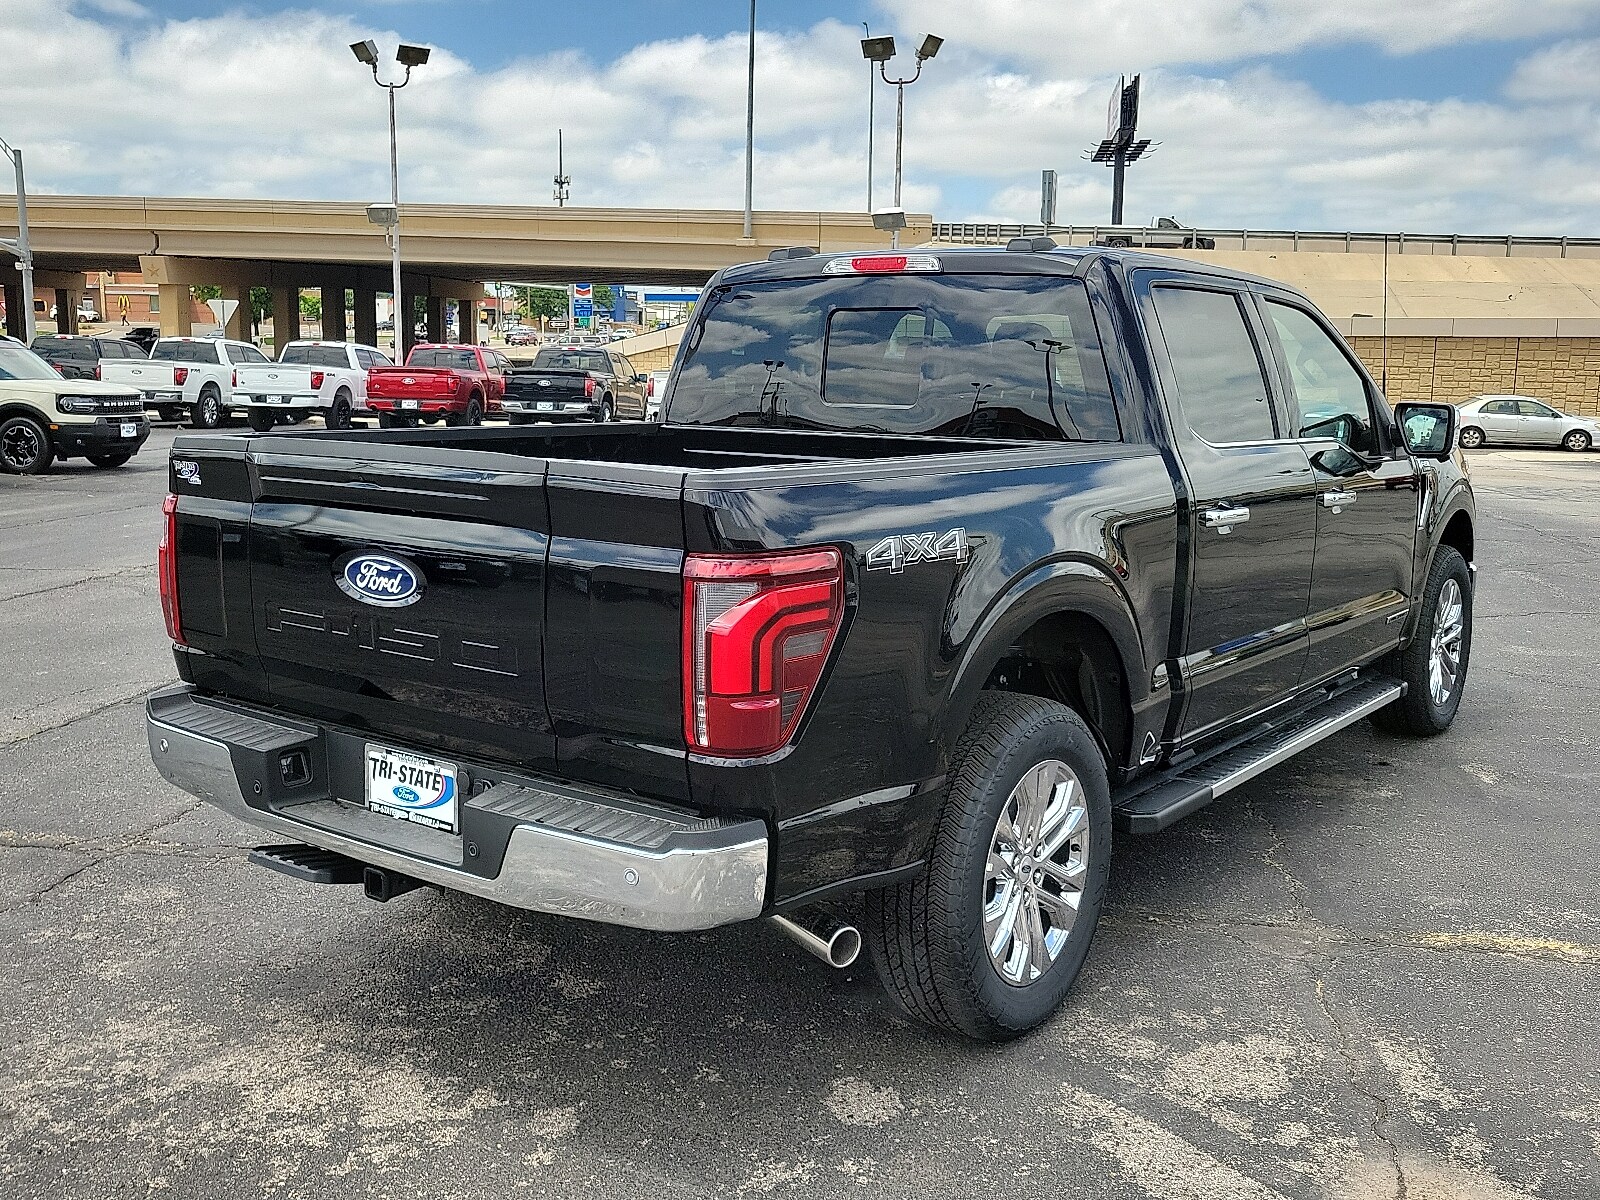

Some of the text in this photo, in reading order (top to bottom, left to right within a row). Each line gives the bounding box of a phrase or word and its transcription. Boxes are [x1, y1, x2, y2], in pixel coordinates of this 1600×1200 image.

[355, 560, 403, 594] Ford
[368, 755, 443, 793] TRI-STATE
[397, 787, 416, 801] Ford
